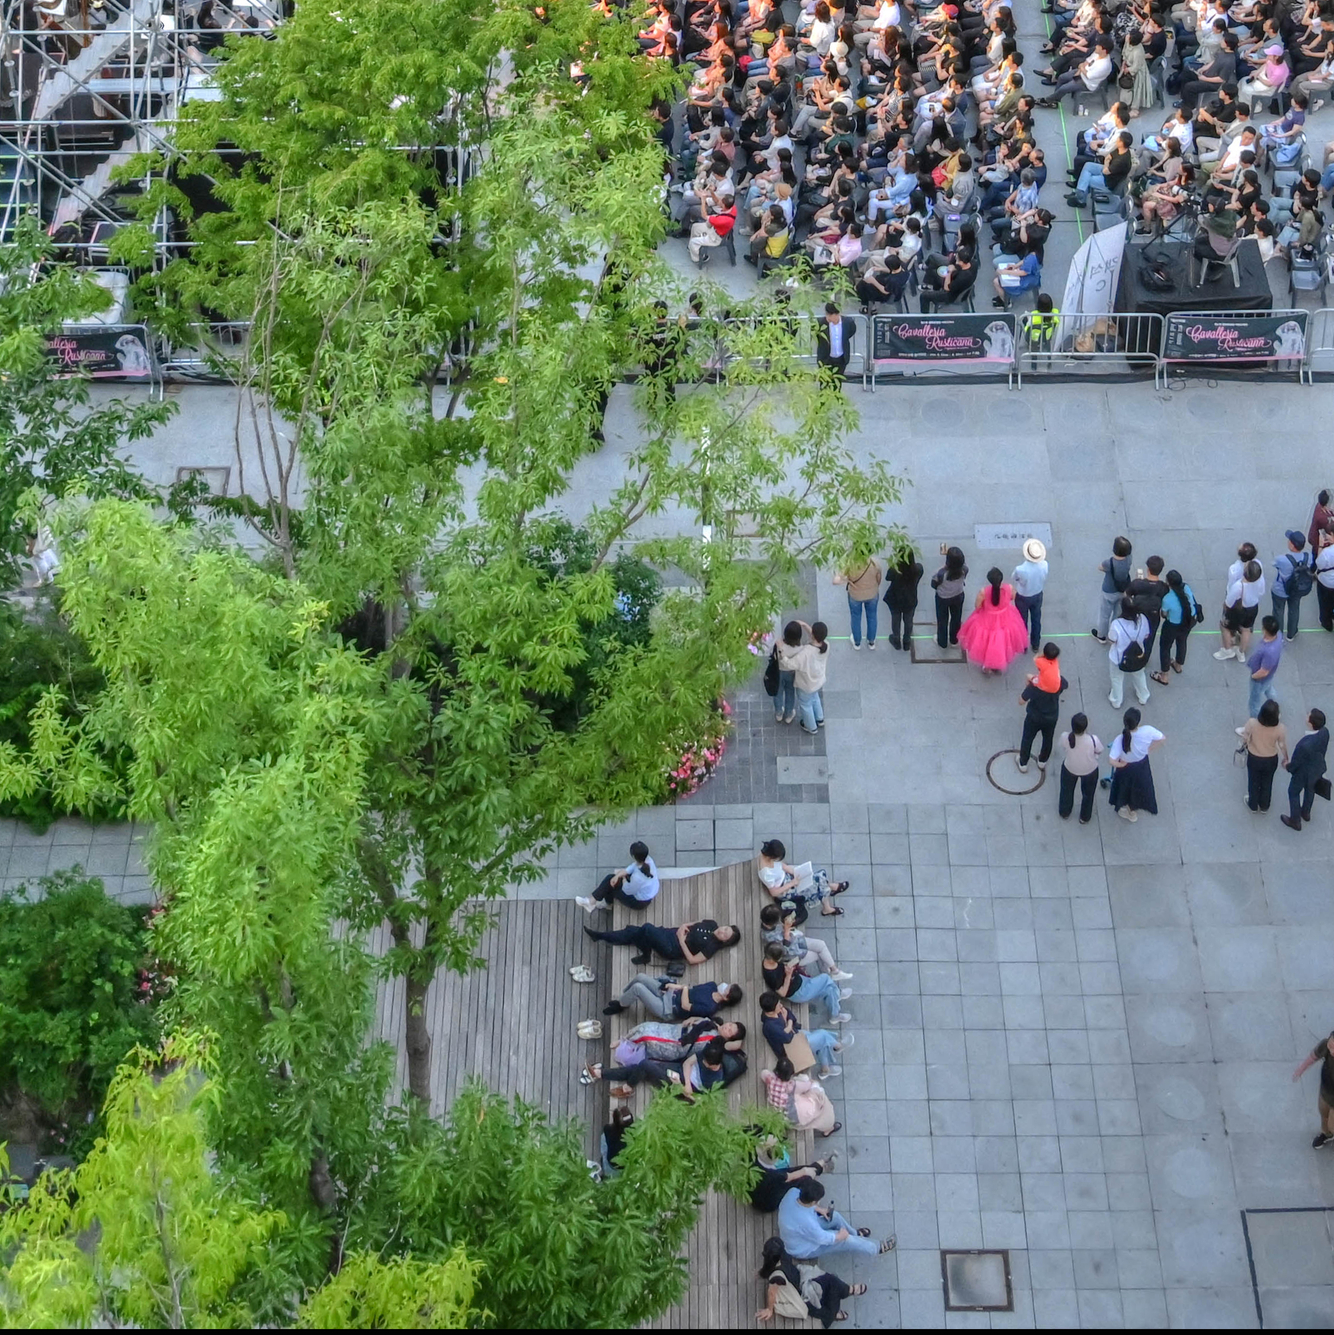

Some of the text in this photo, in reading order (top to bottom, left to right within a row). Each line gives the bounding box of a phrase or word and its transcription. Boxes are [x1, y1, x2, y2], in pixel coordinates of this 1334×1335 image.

[893, 323, 946, 339] Cavalleria
[1186, 324, 1239, 343] Cavalleria
[925, 335, 982, 351] Rusticana
